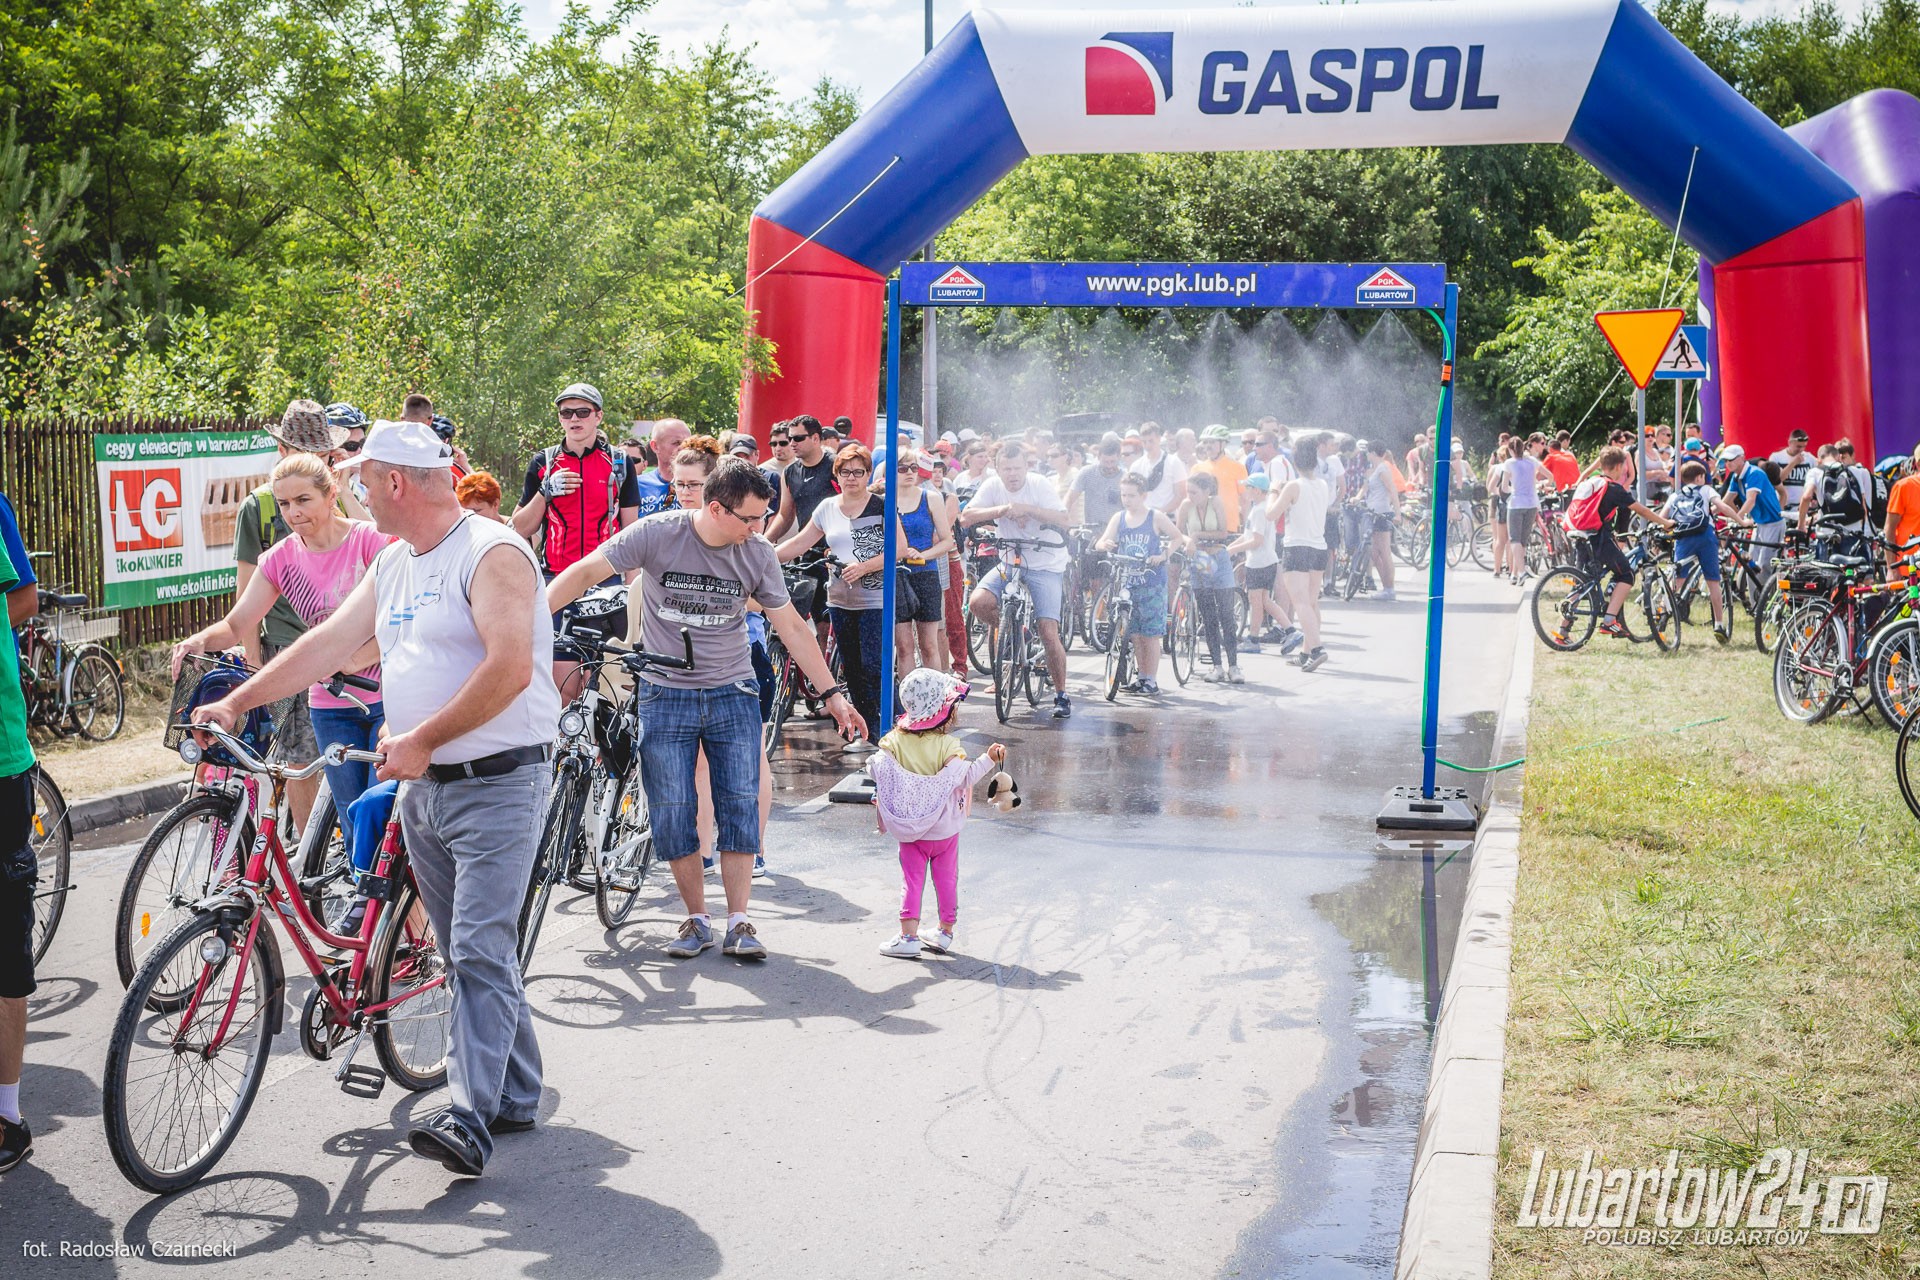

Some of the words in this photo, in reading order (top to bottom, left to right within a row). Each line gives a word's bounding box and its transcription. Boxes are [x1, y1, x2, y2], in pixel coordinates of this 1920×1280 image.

[1198, 44, 1500, 115] GASPOL
[1086, 272, 1257, 297] www.pgk.lub.pl
[1377, 278, 1395, 286] PGK
[937, 288, 979, 297] LUBARTÓW
[1364, 290, 1409, 299] LUBARTÓW
[196, 439, 207, 452] w
[207, 436, 249, 452] barwach
[641, 495, 656, 505] NO
[641, 504, 656, 513] NO
[666, 573, 702, 584] CRUISER
[665, 581, 688, 589] GRAND
[689, 583, 704, 591] PRIX
[664, 597, 708, 609] CRUISER
[680, 605, 707, 615] TEAM
